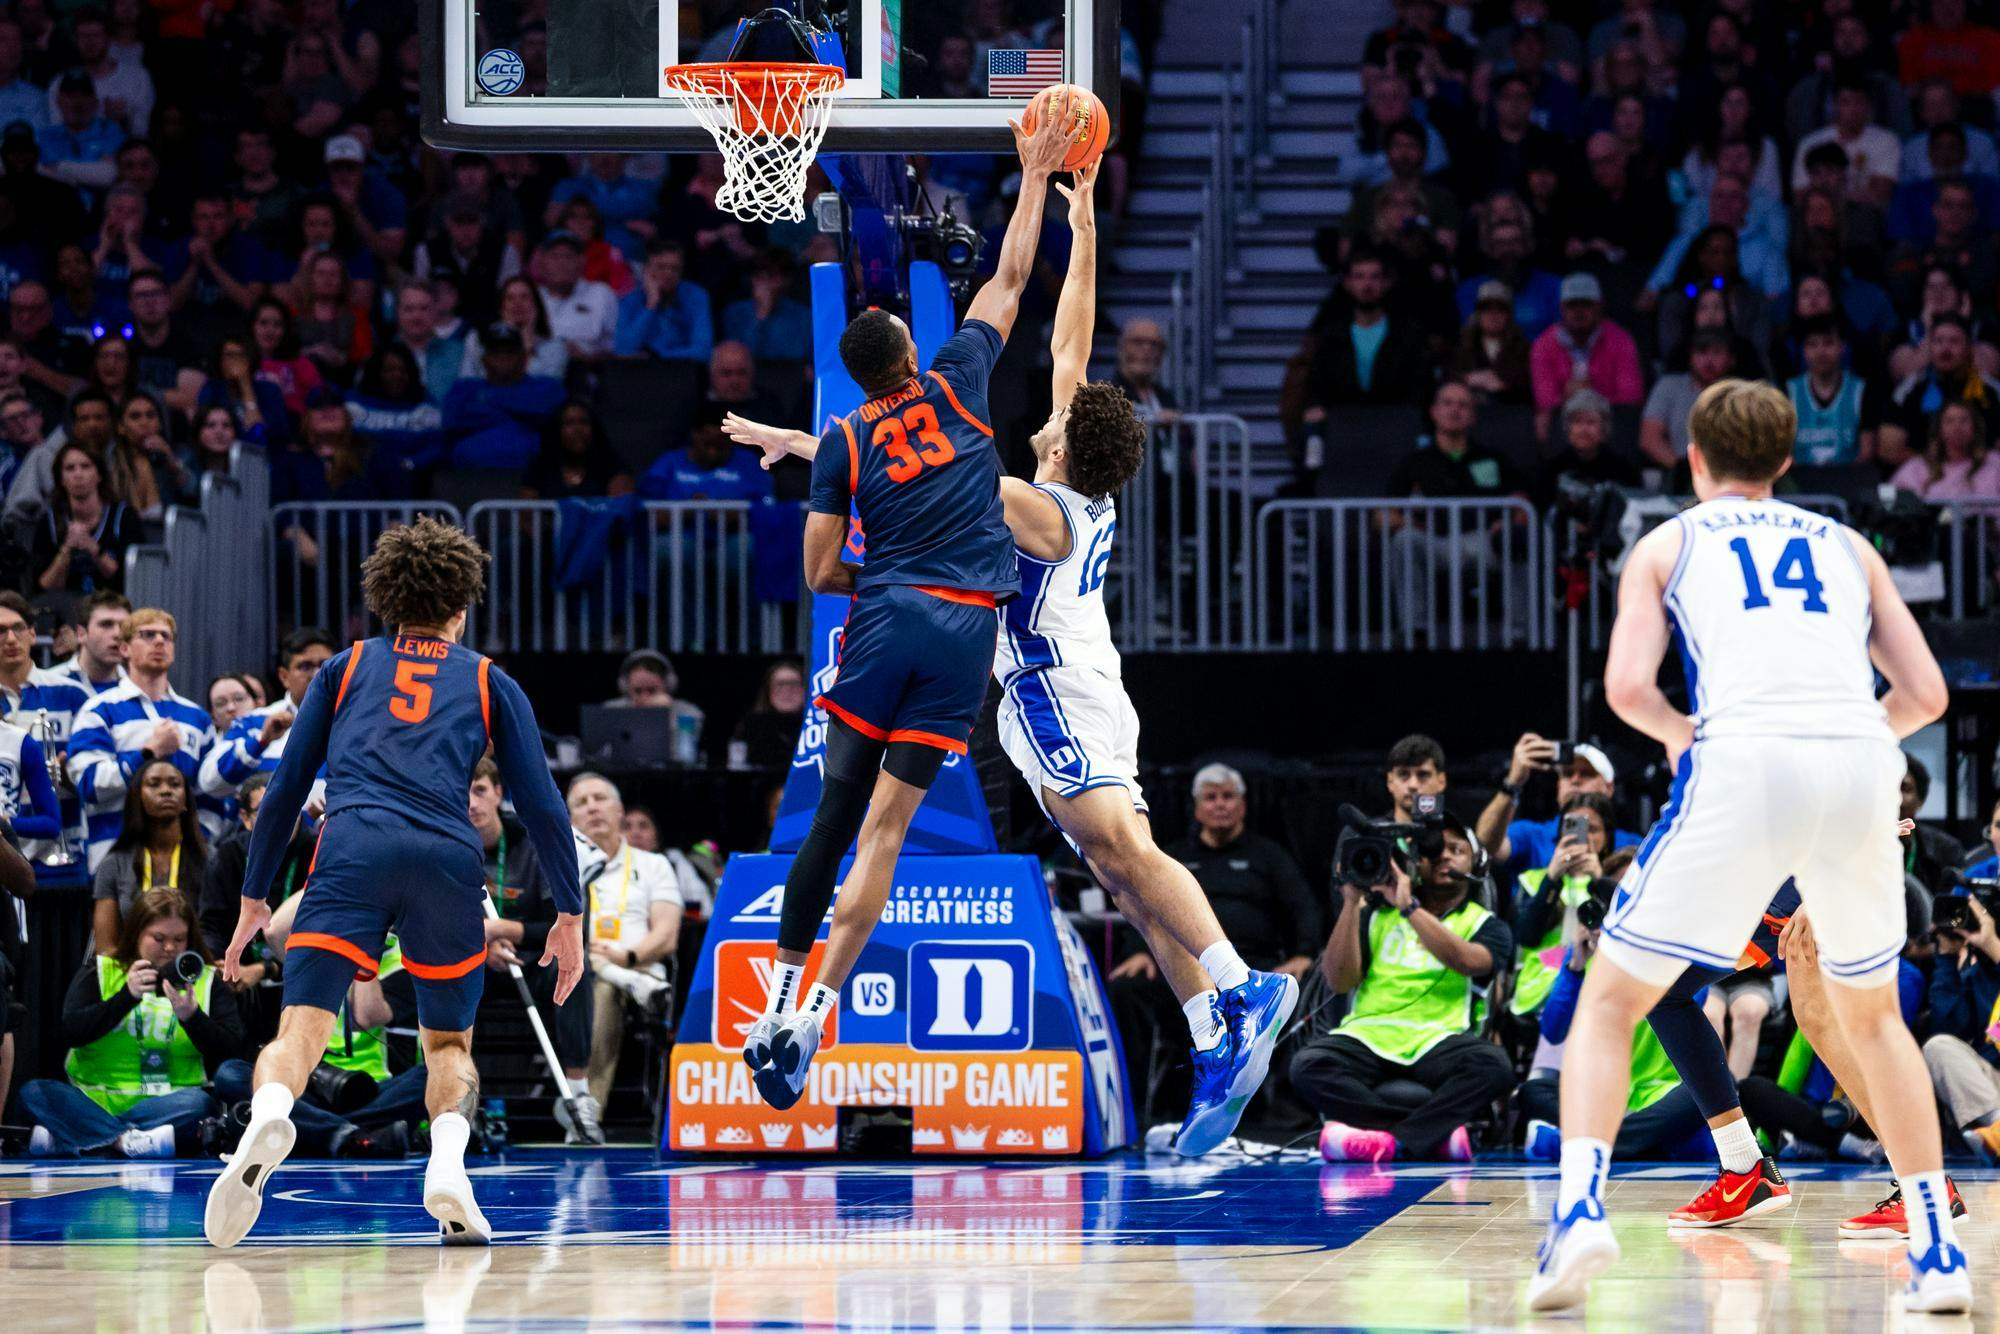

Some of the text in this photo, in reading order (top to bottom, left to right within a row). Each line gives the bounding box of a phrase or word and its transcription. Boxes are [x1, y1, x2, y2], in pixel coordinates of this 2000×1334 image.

[485, 64, 521, 74] ACC
[872, 402, 957, 484] 33
[1078, 519, 1117, 597] 12
[1729, 537, 1829, 614] 14
[393, 636, 449, 660] LEWIS
[389, 660, 439, 724] 5
[881, 900, 1013, 924] GREATNESS
[896, 886, 1013, 899] CCOMPLISH
[861, 982, 887, 1007] VS
[928, 958, 1014, 1035] D
[677, 1061, 1069, 1107] CHAIONSHIP GAME
